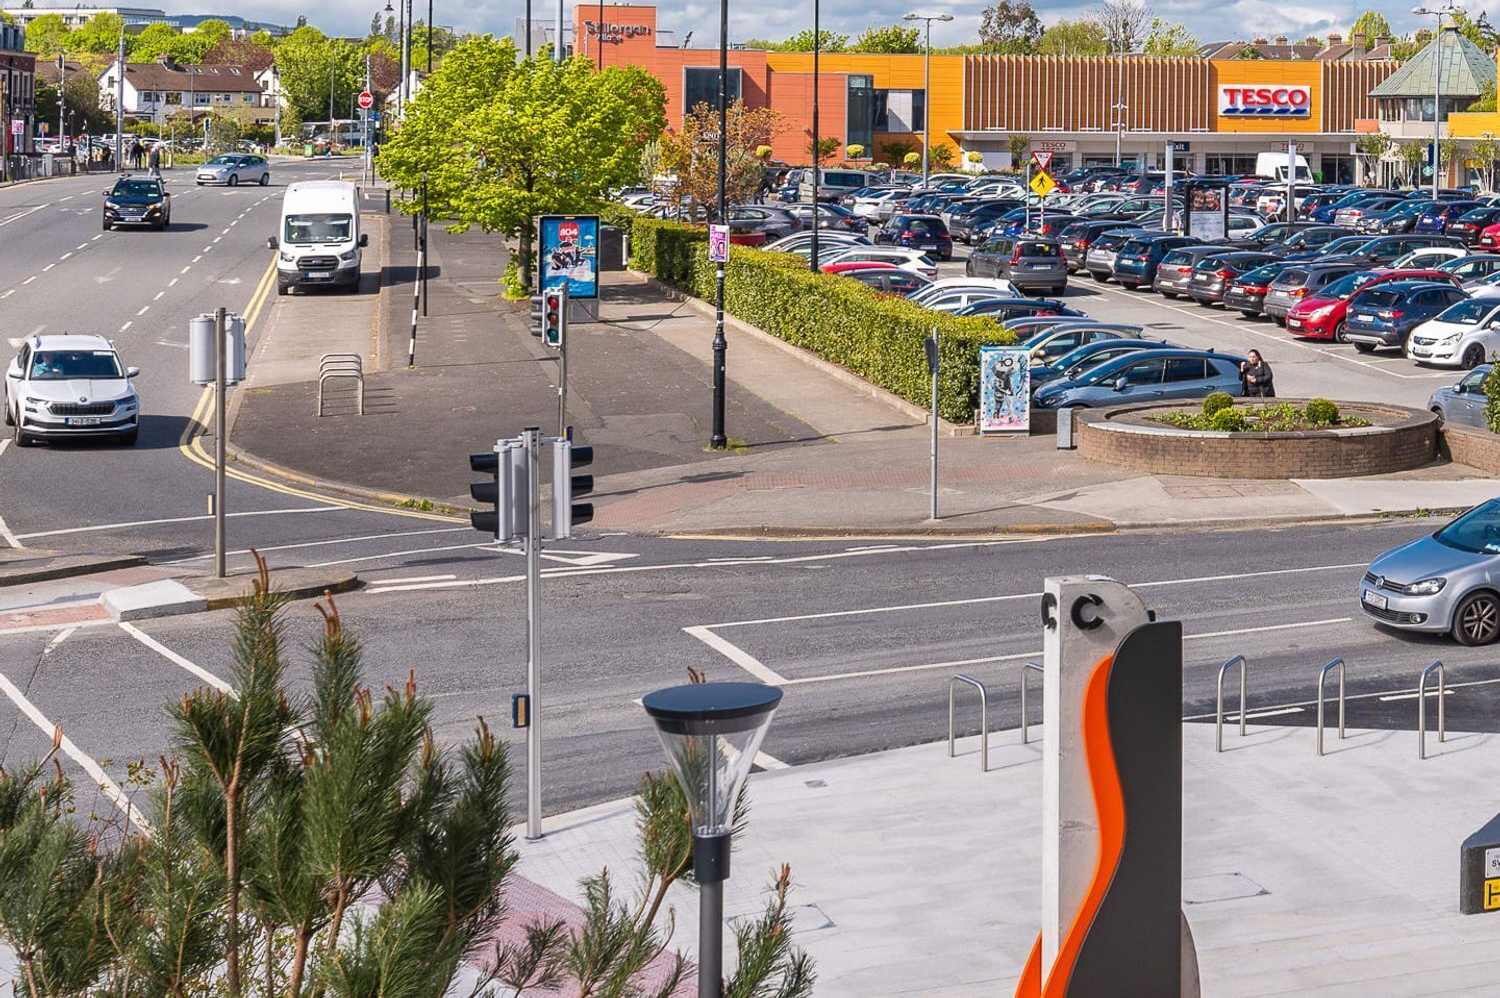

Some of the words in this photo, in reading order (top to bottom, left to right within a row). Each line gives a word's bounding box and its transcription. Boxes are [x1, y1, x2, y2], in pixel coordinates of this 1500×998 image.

[587, 21, 650, 37] Stllorgan
[595, 33, 622, 44] Vllage
[1223, 89, 1308, 106] TESCO
